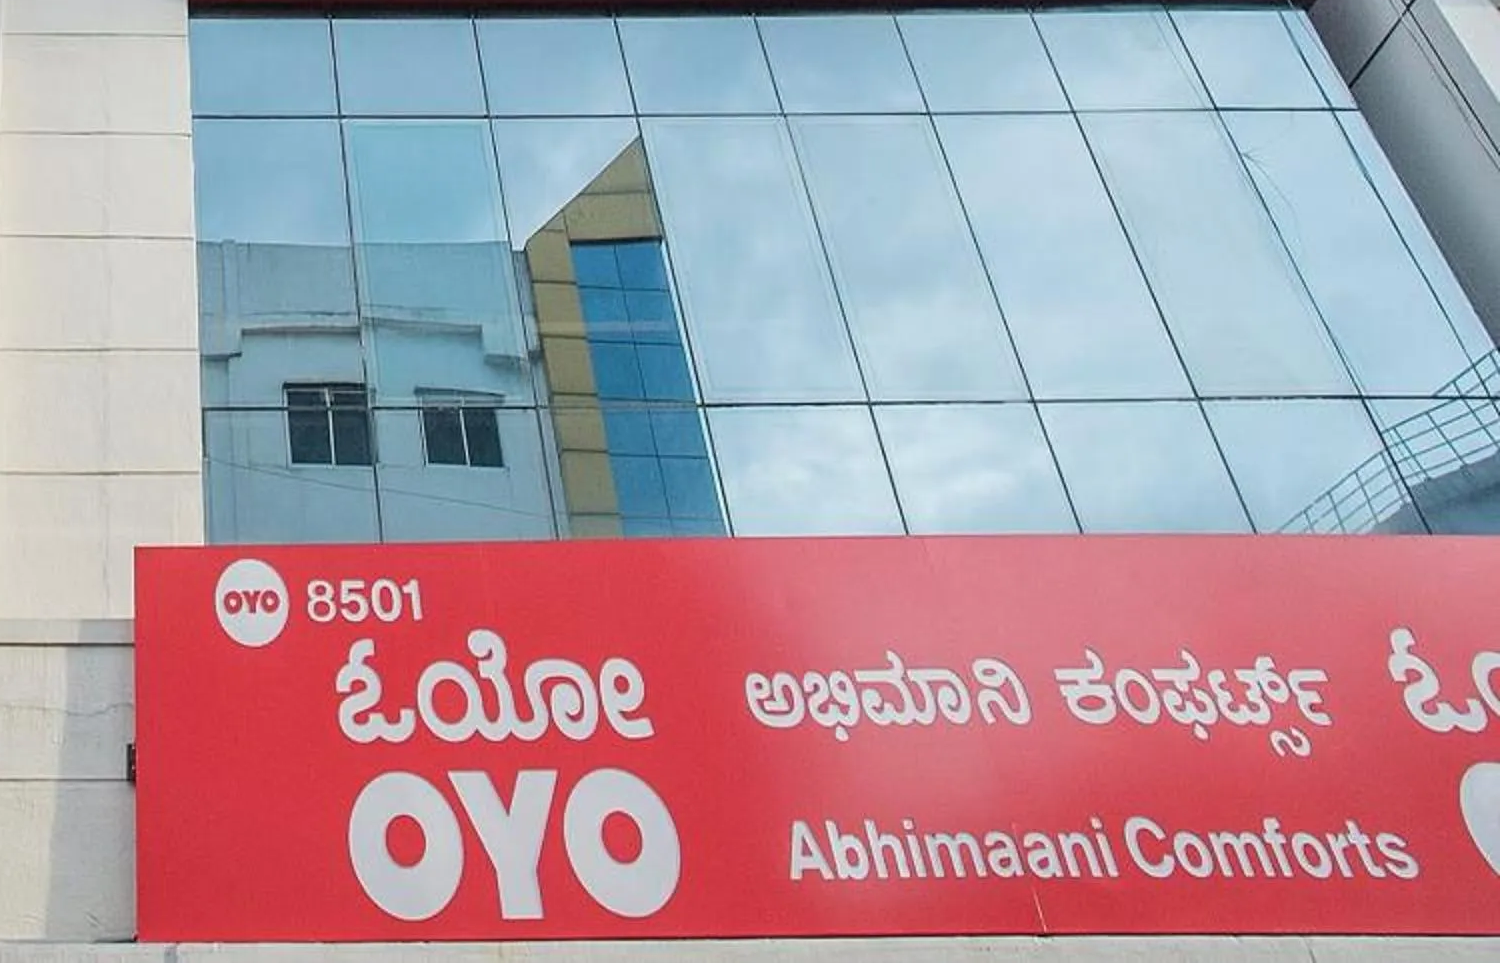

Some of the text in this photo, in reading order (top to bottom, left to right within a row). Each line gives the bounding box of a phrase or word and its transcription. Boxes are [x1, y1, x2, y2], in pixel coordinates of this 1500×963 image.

[223, 578, 423, 622] OYO 8501
[336, 628, 654, 743] ಓಯೋ
[744, 649, 1032, 742] ಅಭಿಮಾನಿ
[348, 768, 682, 921] OYO
[789, 817, 1119, 881] Abhimaani
[1123, 816, 1420, 880] Comforts
